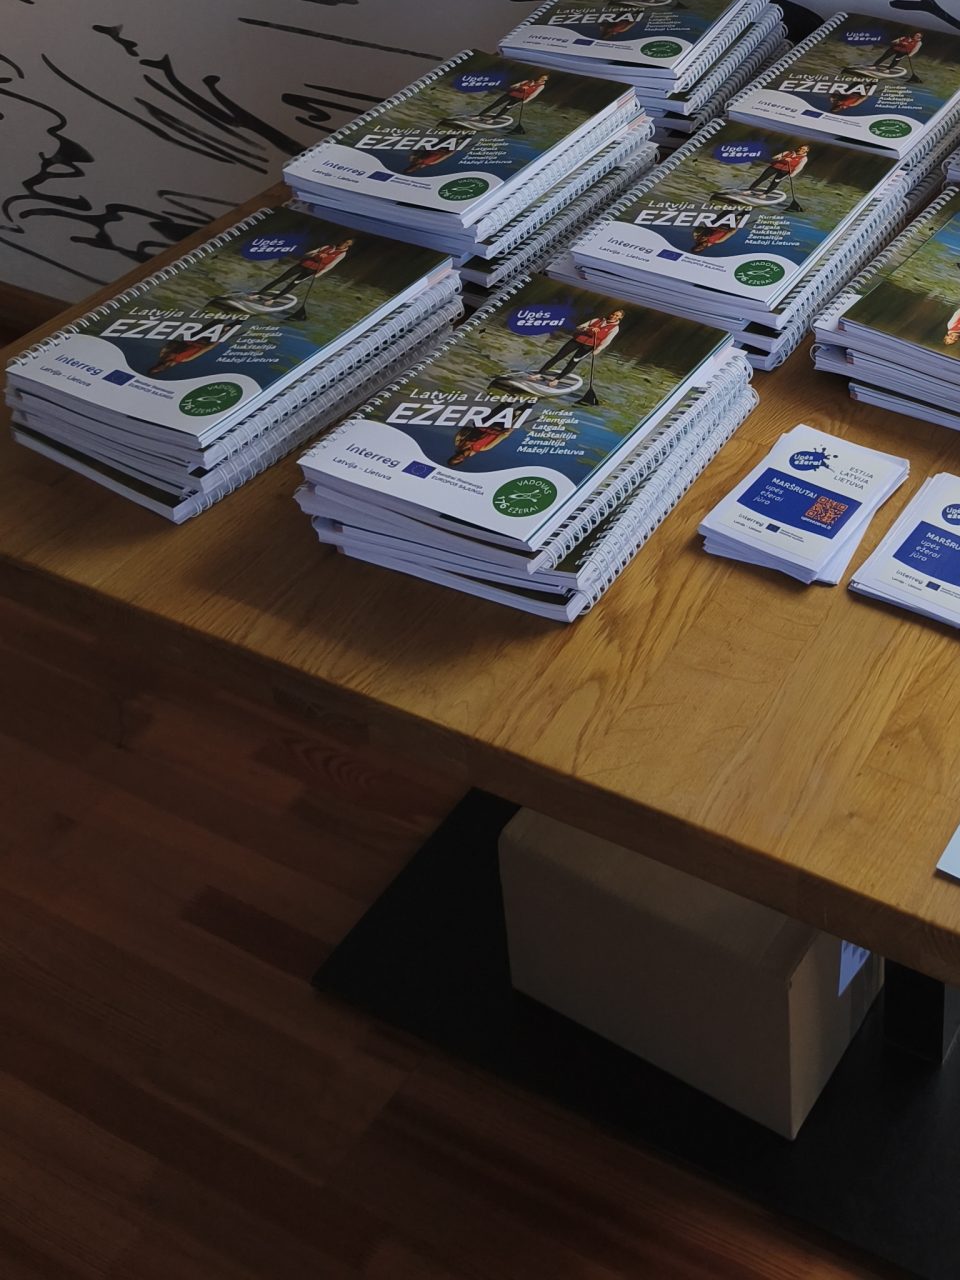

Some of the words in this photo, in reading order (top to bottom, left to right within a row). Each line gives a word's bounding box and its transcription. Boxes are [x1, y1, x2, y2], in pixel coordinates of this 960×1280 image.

[547, 12, 644, 24] EŽERAI
[778, 79, 877, 94] EŽERAI
[374, 127, 420, 135] Latvija
[354, 133, 472, 149] EŽERAI
[649, 200, 695, 209] Latvija
[634, 208, 750, 227] EŽERAI
[253, 238, 284, 247] Upės
[129, 307, 184, 318] Latvija
[189, 310, 250, 319] Lietuva
[518, 310, 550, 320] Upės
[517, 317, 564, 325] ežerai
[99, 317, 242, 341] EŽERAI
[410, 388, 468, 402] Latvija
[474, 392, 538, 402] Lietuva
[386, 400, 532, 428] EŽERAI
[536, 414, 578, 423] Žiemgala
[521, 437, 565, 445] Žemaitija
[345, 443, 402, 468] Interreg
[331, 456, 359, 468] Latvija
[363, 467, 393, 480] Lietuva
[848, 466, 874, 478] ESTIJA
[832, 475, 865, 490] LIETUVA
[838, 470, 870, 484] LATVIJA
[517, 480, 550, 494] VADOVAS
[770, 477, 818, 499] MARŠRUTAI
[496, 496, 507, 509] 176
